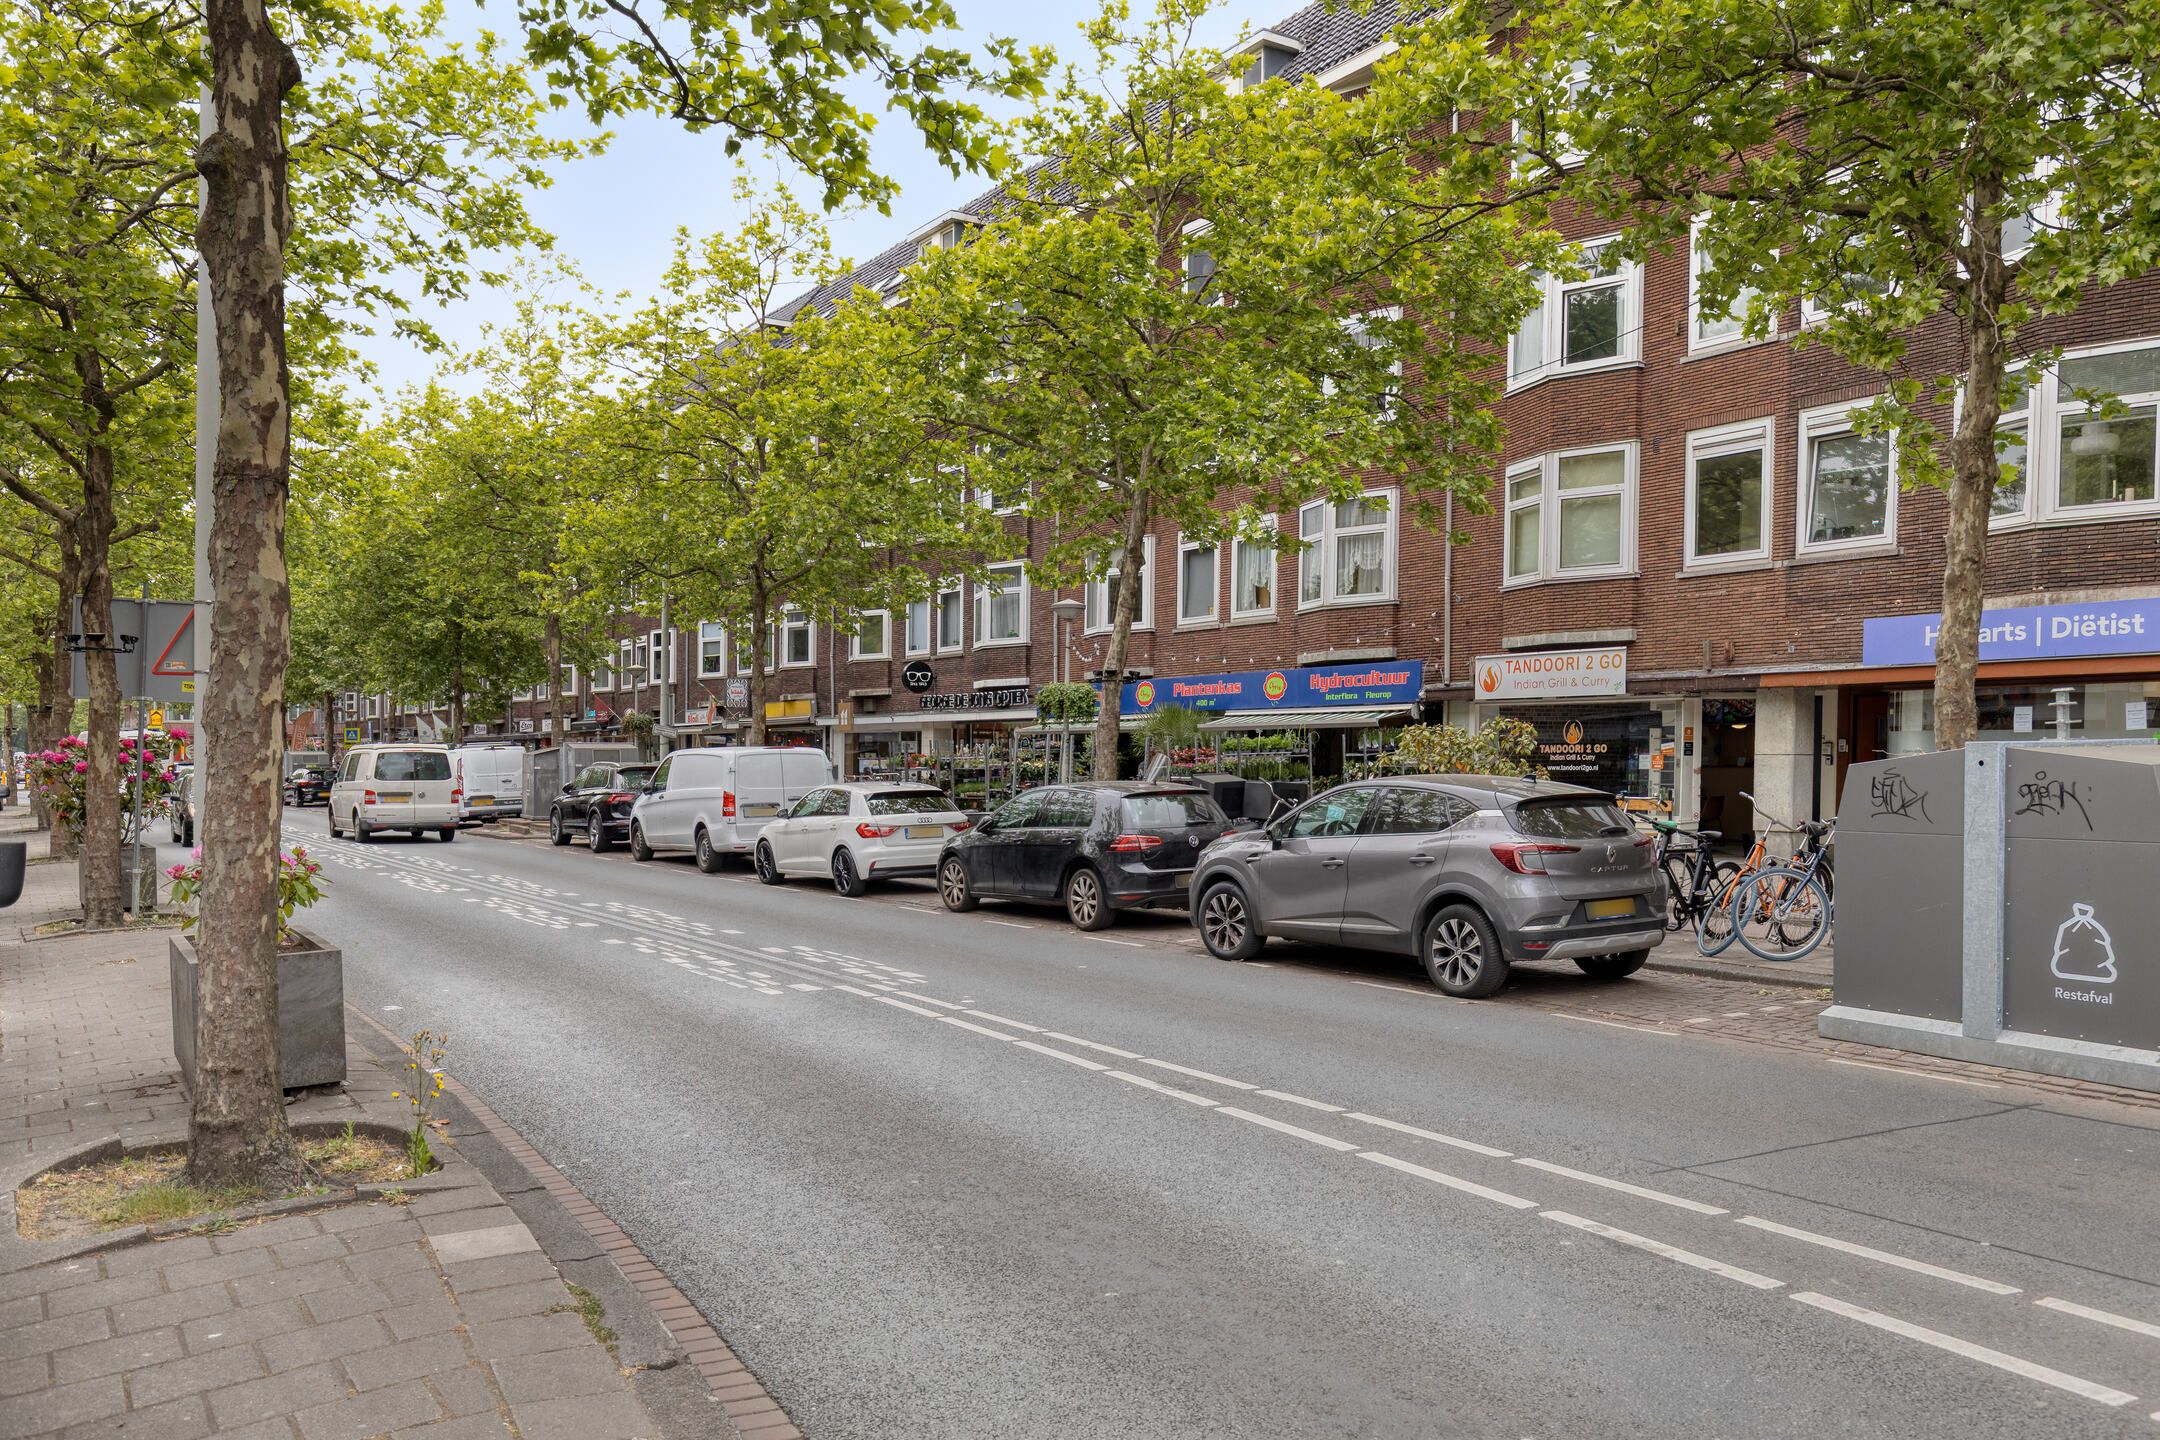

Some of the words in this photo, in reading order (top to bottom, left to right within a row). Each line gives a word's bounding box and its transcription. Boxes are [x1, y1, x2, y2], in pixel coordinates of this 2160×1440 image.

[1924, 621, 2027, 647] Harts
[2051, 612, 2145, 639] Diëtist
[1505, 655, 1580, 674] TANDOORI
[1586, 655, 1594, 670] 2
[1600, 653, 1623, 670] GO
[1309, 669, 1411, 693] Hydrocultuur
[1514, 678, 1545, 690] Indian
[1548, 677, 1568, 689] Grill
[1570, 678, 1578, 688] &
[1581, 676, 1611, 689] Curry
[1173, 680, 1242, 698] Plantenkas
[1325, 692, 1358, 701] Interflora
[1365, 691, 1392, 700] Fleurop
[1540, 744, 1584, 754] TANDOORI
[1586, 744, 1592, 753] 2
[1594, 743, 1608, 754] GO
[1582, 753, 1596, 762] Curry
[1547, 763, 1599, 772] www.tandoori2go.nl
[1590, 864, 1630, 873] CAPTUR
[2054, 986, 2113, 1005] Restafval
